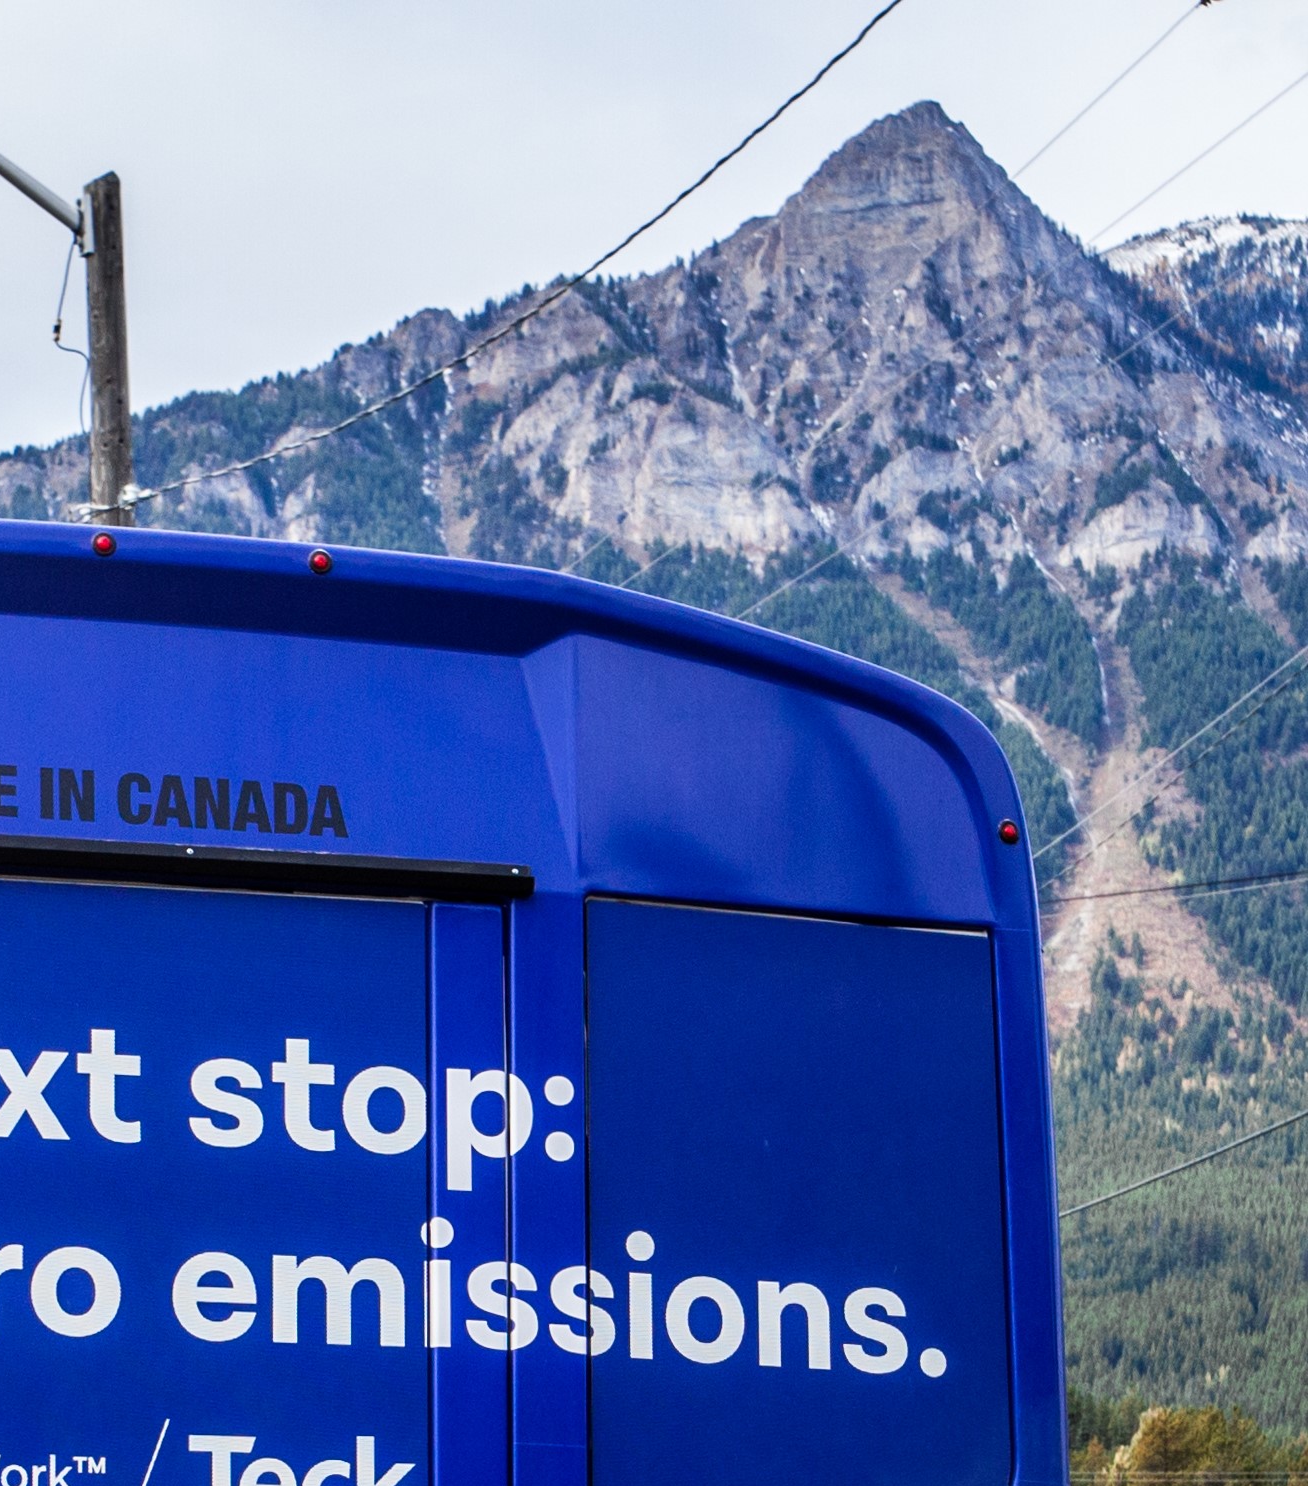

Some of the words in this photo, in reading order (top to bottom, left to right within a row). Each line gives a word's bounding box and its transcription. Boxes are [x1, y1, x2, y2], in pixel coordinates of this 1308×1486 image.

[42, 767, 95, 821] IN
[118, 773, 348, 838] CANADA
[189, 1039, 575, 1192] stop:
[171, 1216, 947, 1378] emissions.
